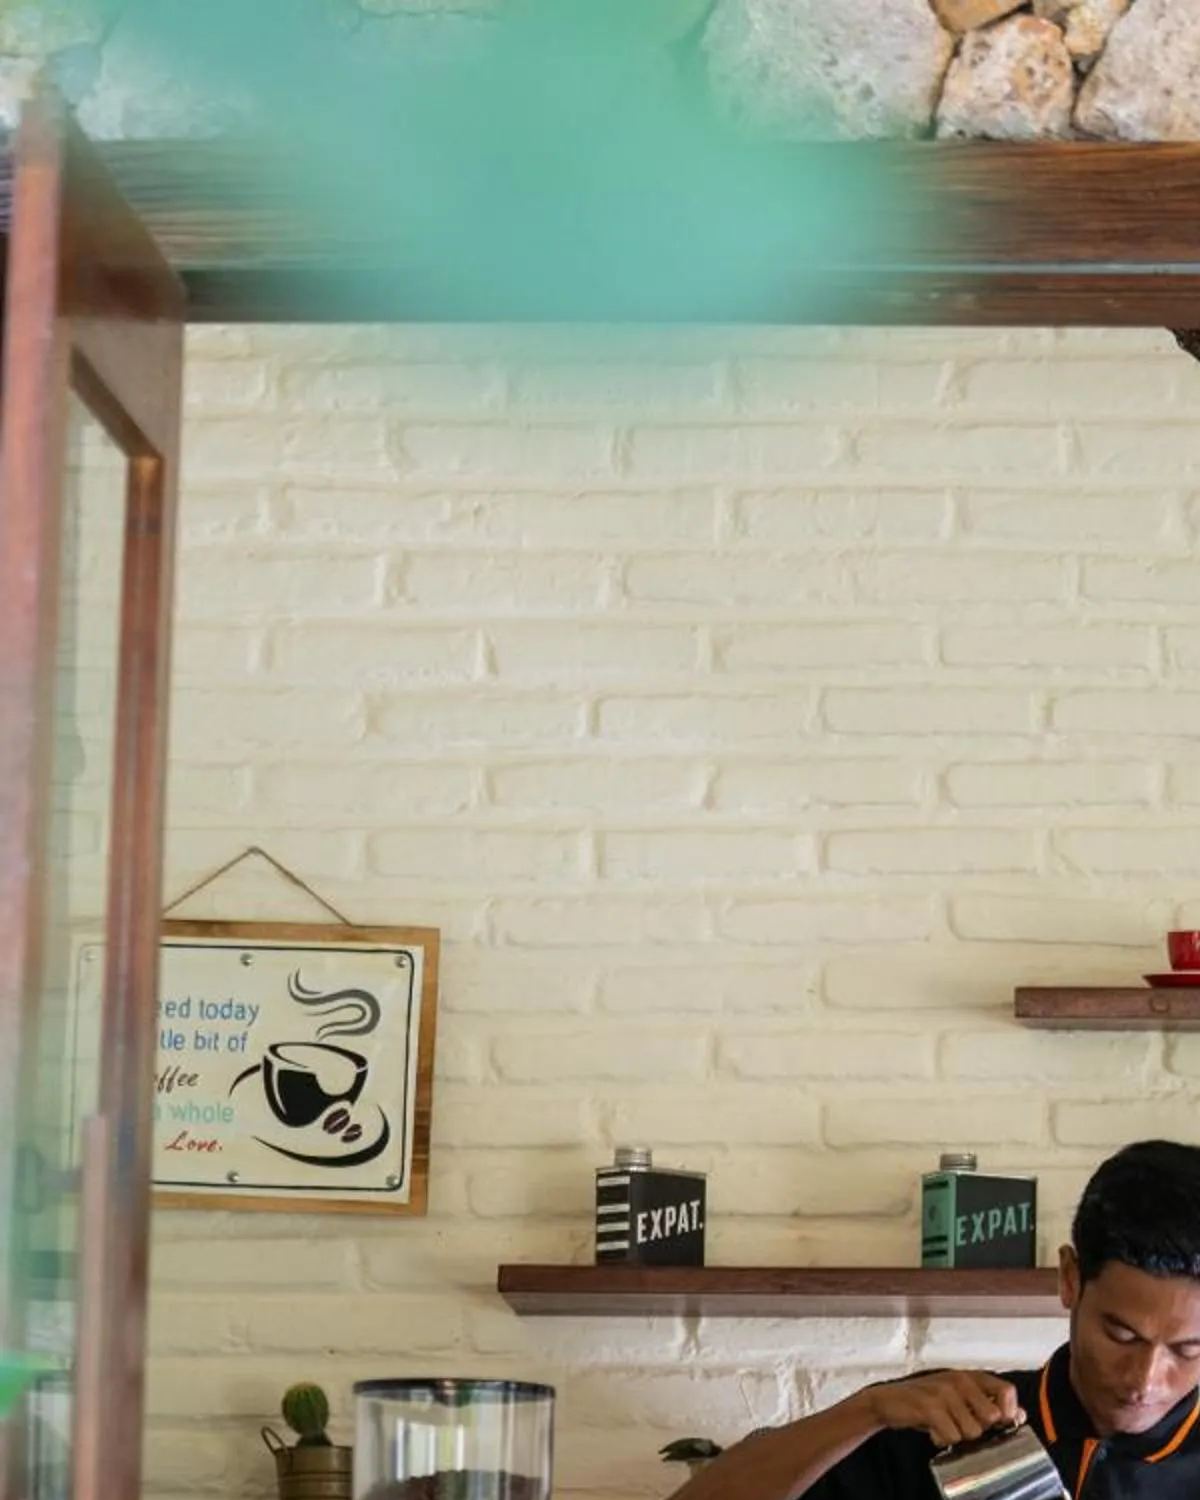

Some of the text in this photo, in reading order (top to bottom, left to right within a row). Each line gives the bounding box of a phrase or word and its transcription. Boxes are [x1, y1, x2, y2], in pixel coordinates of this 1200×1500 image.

[157, 996, 259, 1027] ed today
[194, 1030, 219, 1051] bit
[227, 1031, 248, 1053] of
[168, 1101, 234, 1123] whole
[164, 1130, 223, 1152] Love.
